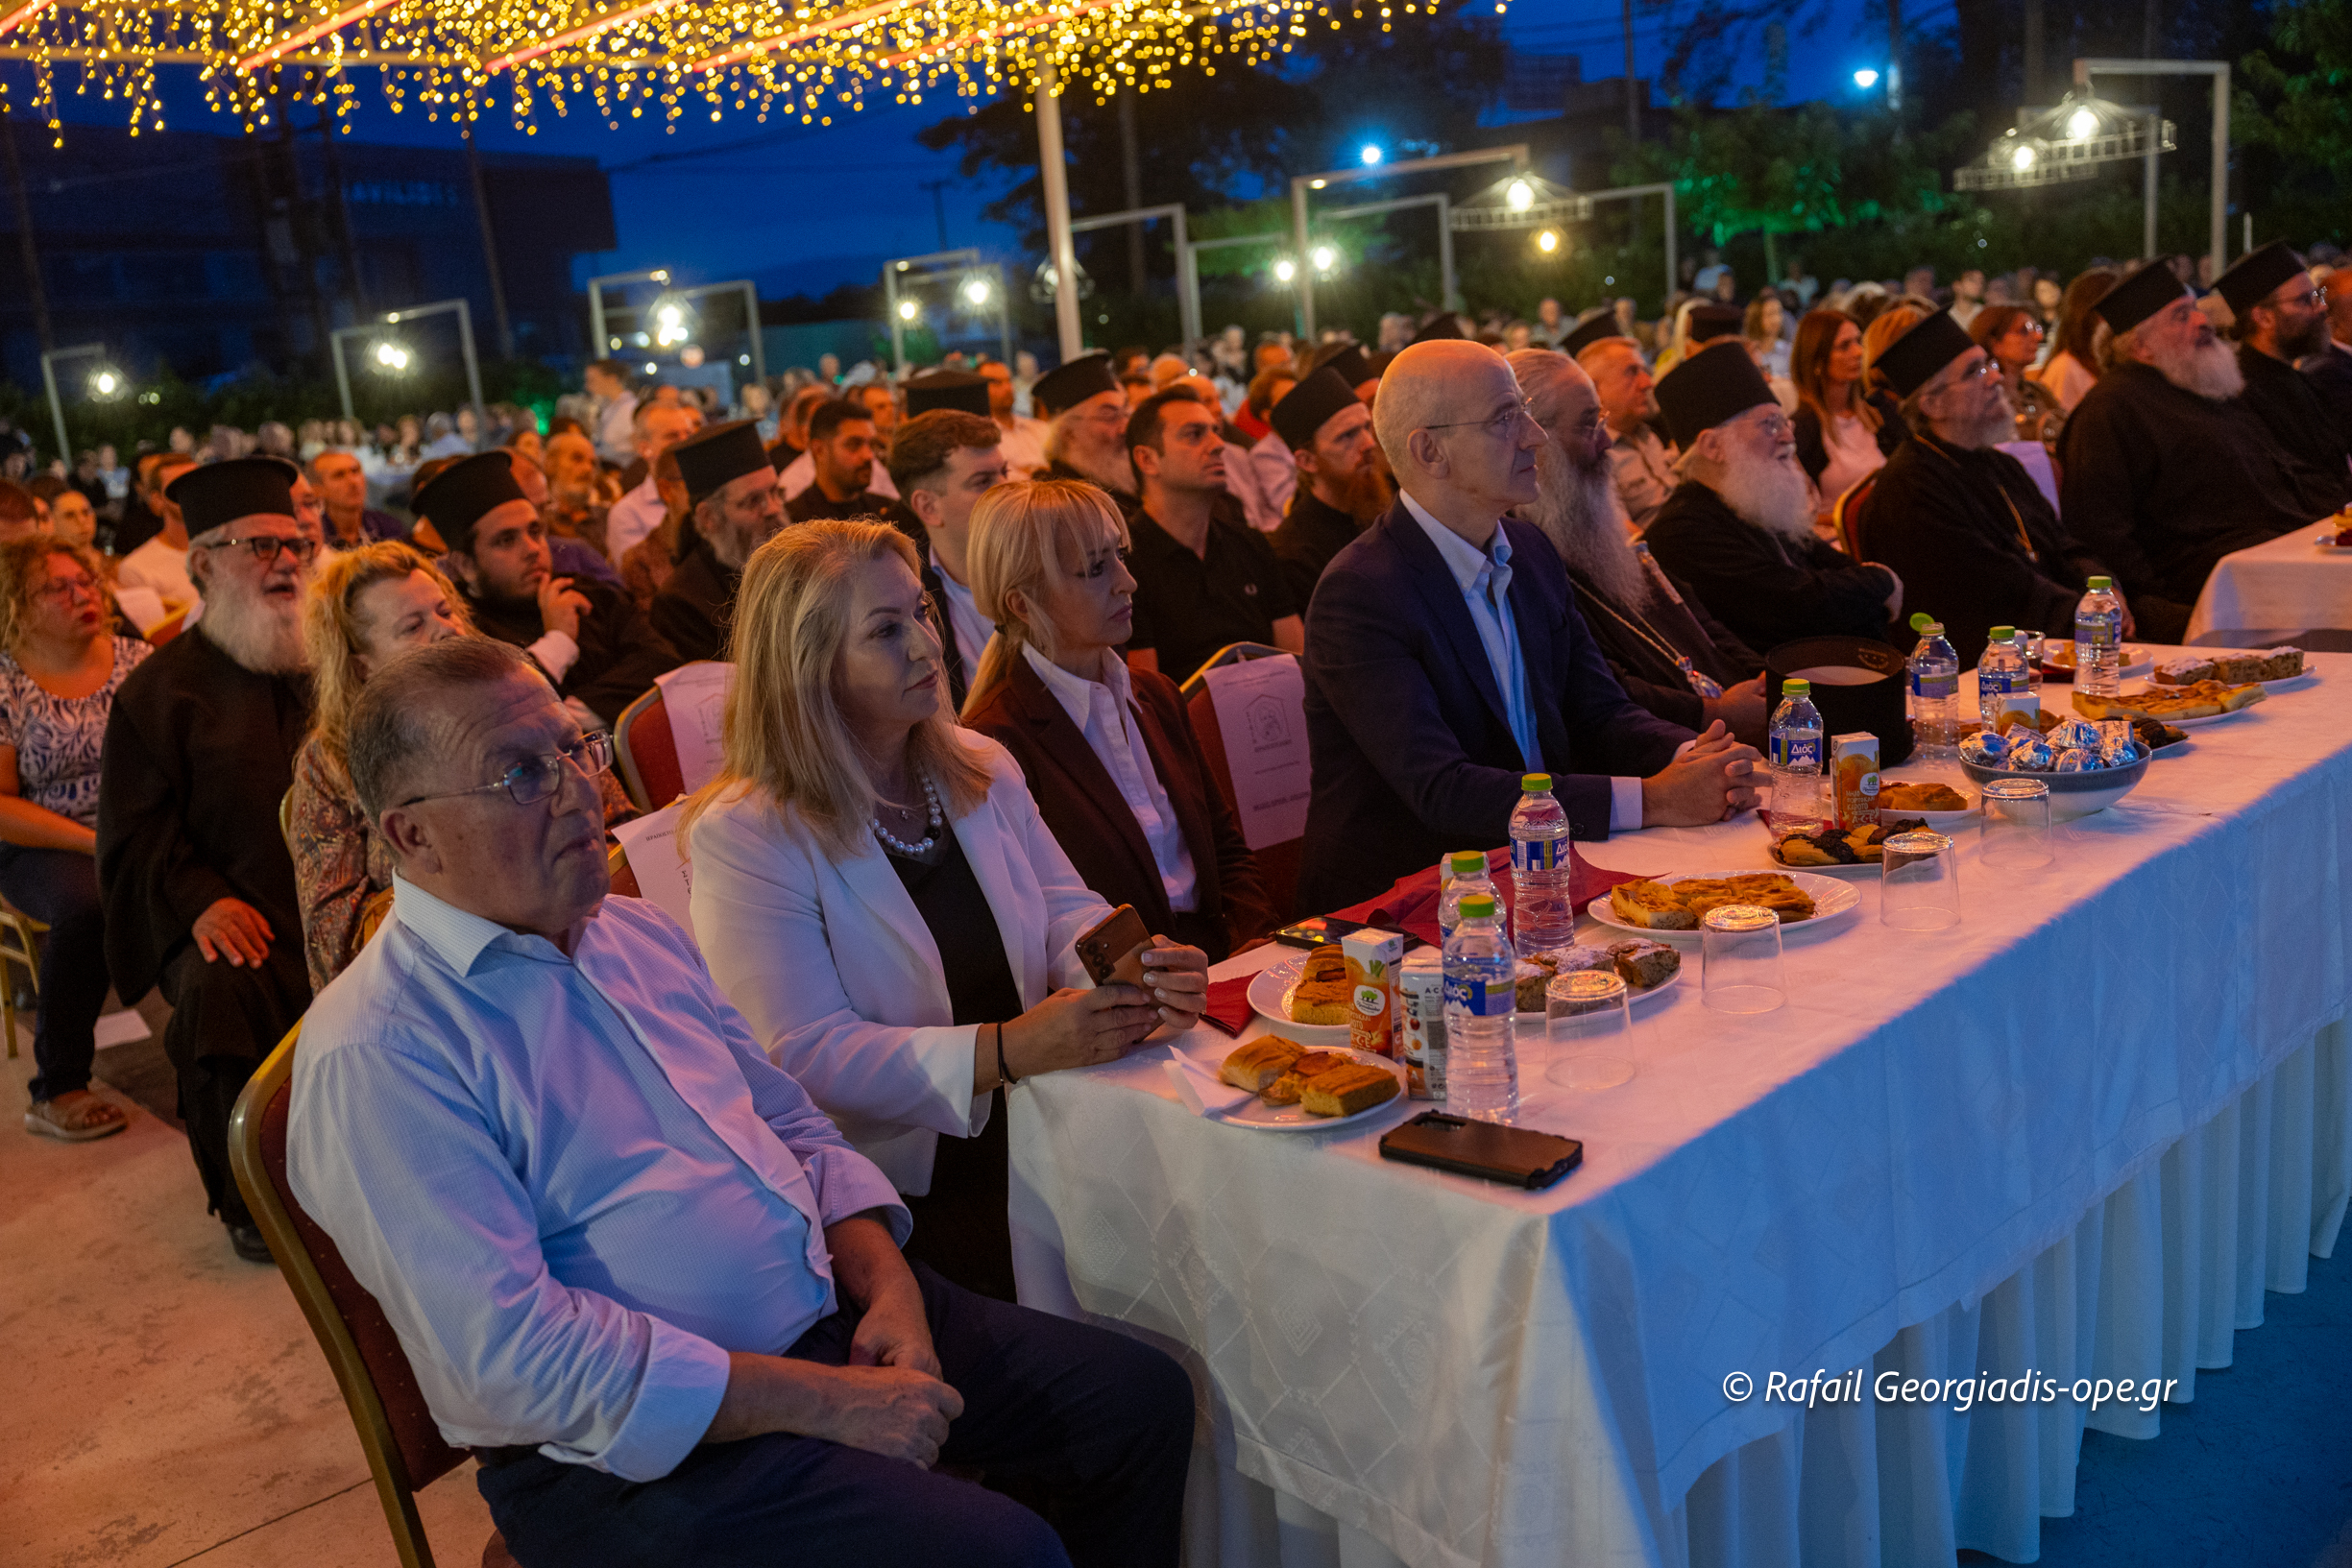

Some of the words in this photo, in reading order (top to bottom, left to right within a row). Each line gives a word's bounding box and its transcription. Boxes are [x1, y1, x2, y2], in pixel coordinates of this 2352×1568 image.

[1791, 743, 1813, 755] Διός
[1556, 841, 1568, 855] Διό
[1443, 980, 1467, 1001] Διός
